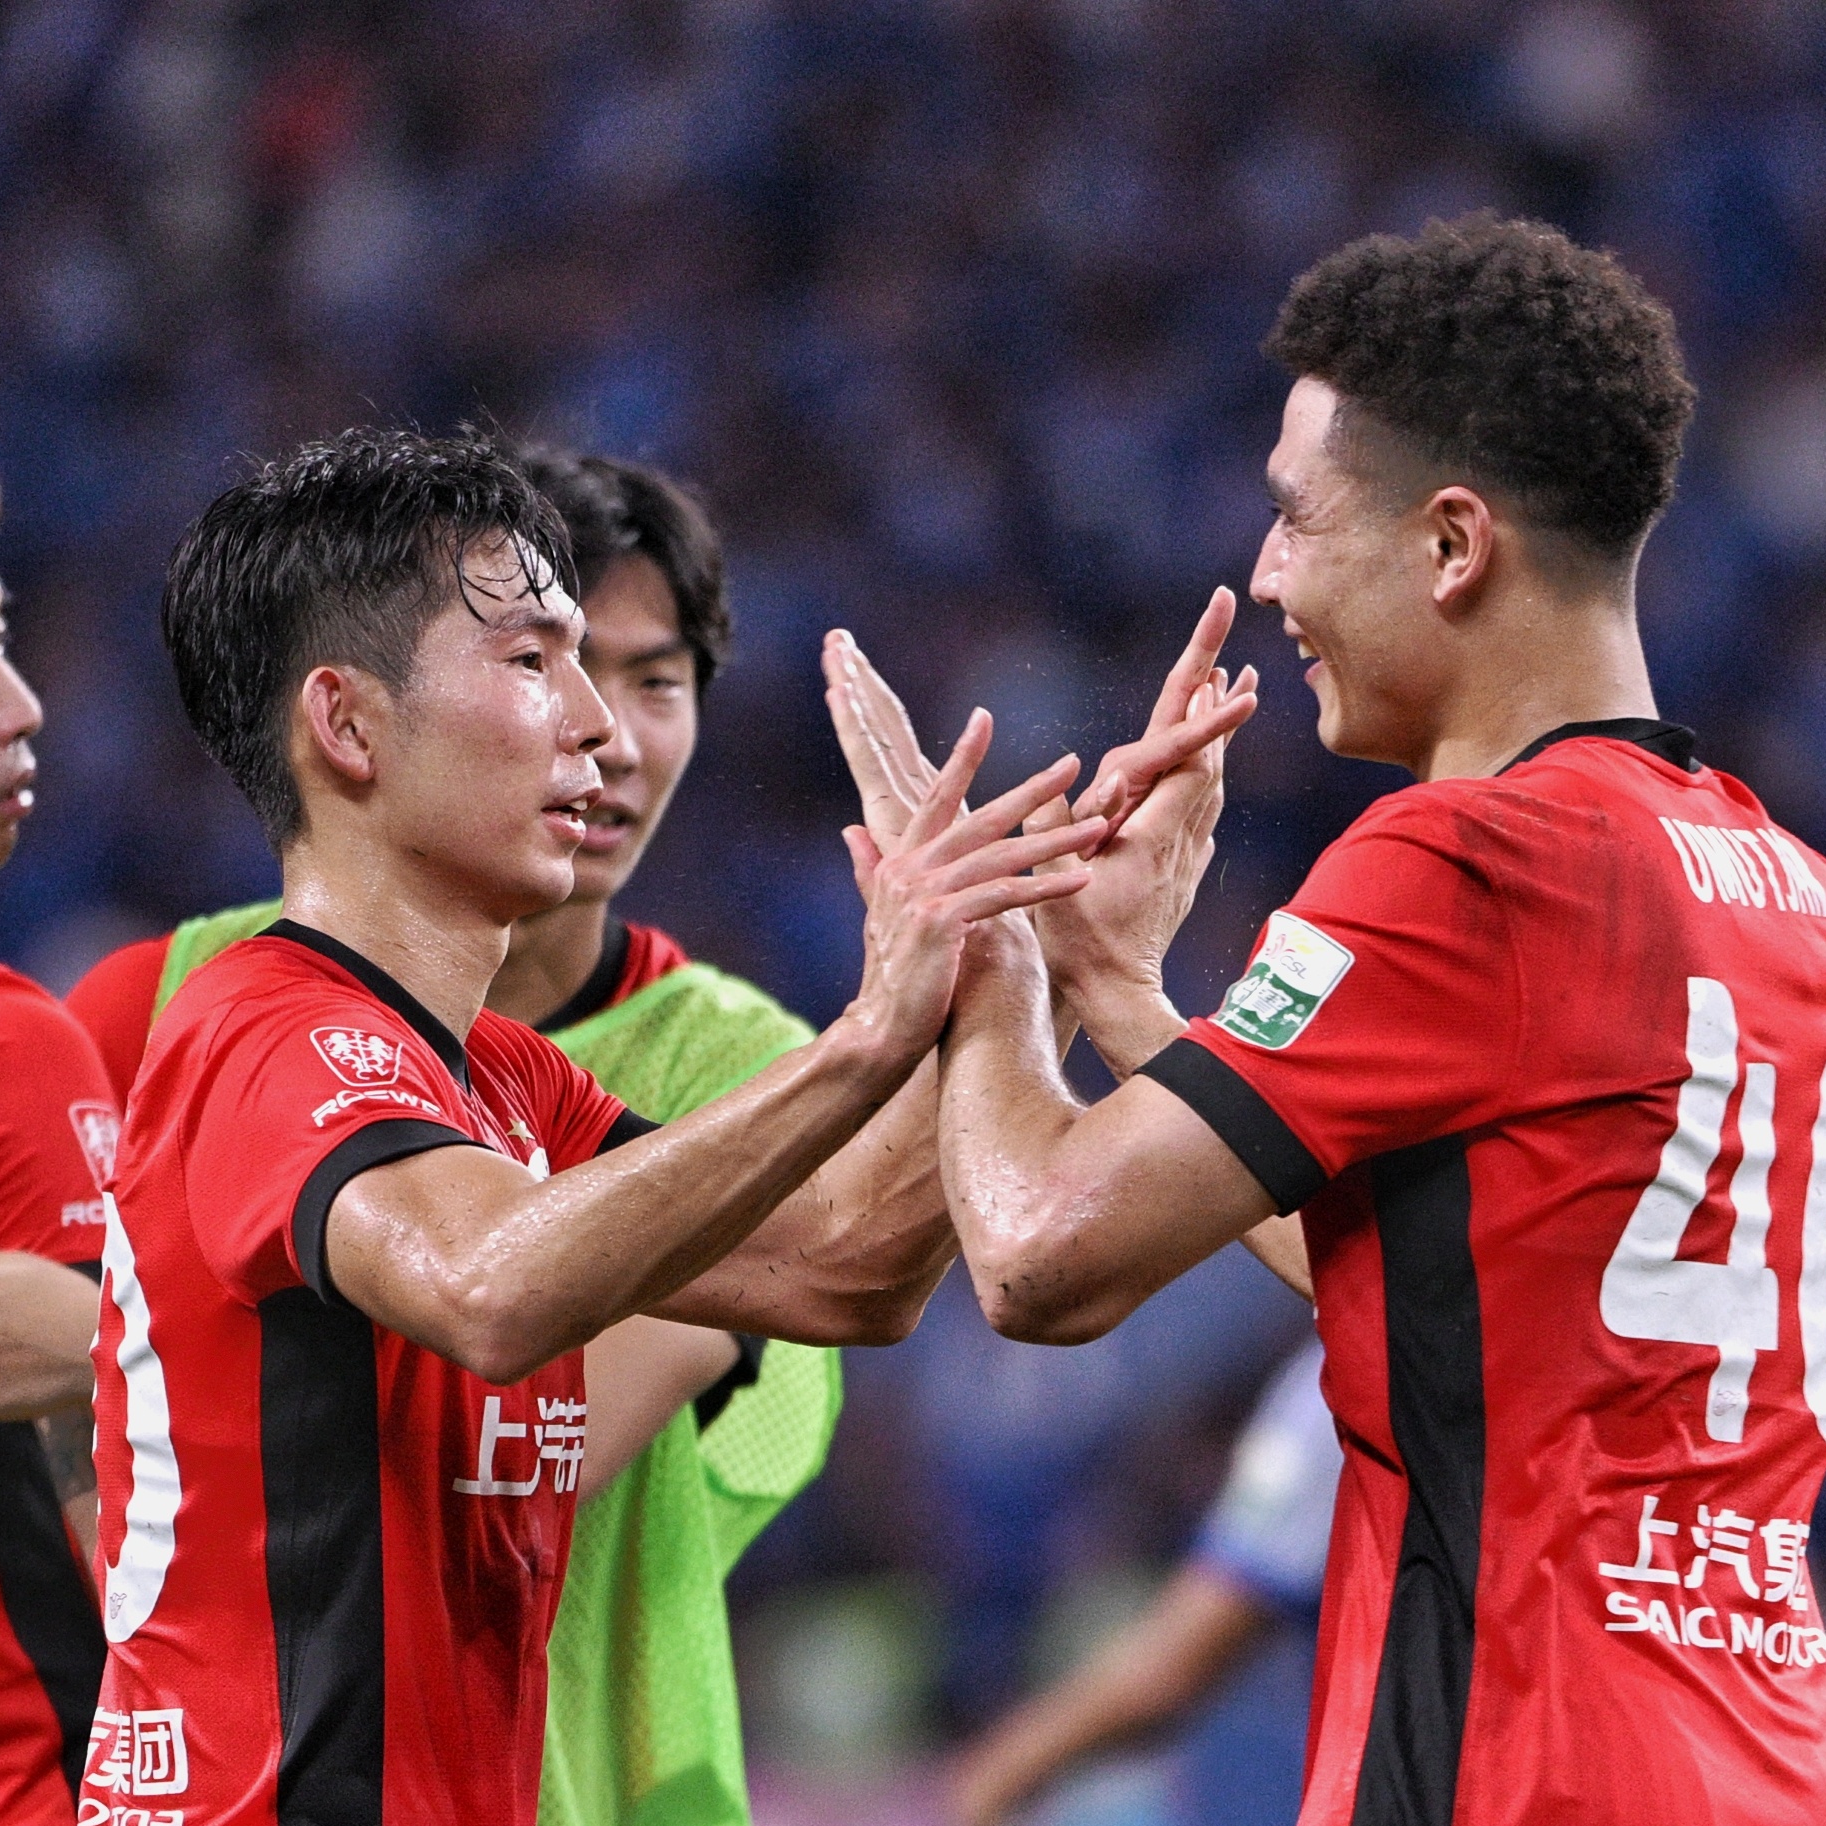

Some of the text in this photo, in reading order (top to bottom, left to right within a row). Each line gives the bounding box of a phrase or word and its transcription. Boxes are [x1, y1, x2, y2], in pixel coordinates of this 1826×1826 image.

[1279, 955, 1307, 980] CSL
[1598, 1494, 1811, 1611] 上汽集
[1604, 1591, 1726, 1648] SAIC
[84, 1706, 189, 1796] 集团
